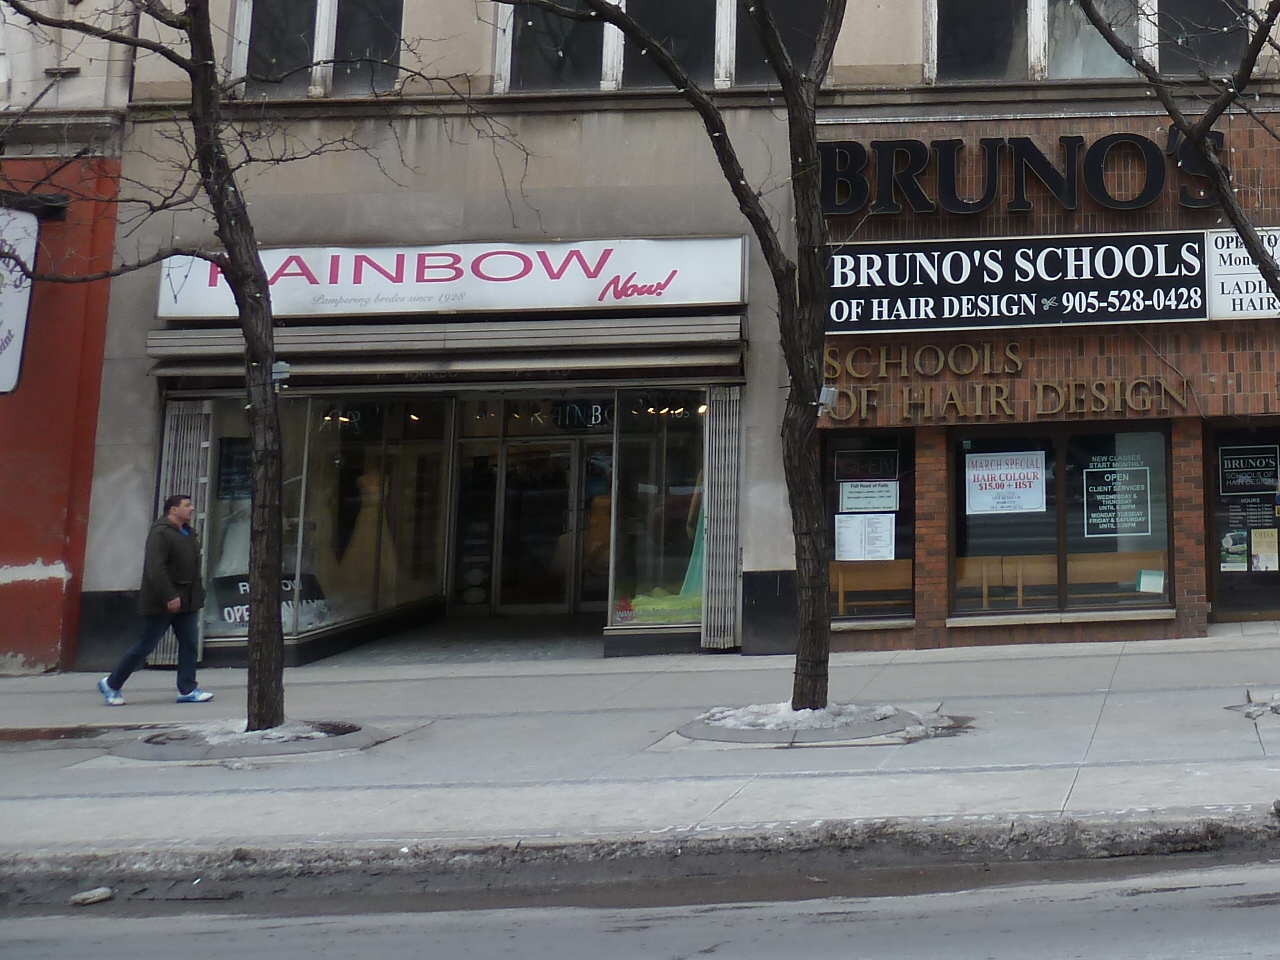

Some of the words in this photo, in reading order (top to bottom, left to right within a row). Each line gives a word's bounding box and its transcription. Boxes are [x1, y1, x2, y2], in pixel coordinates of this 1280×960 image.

[817, 123, 1229, 215] BRUNO'S
[830, 248, 1004, 288] BRUNO'S
[1015, 242, 1202, 283] SCHOOLS
[597, 269, 678, 302] Now!
[310, 293, 371, 307] Pampering
[374, 293, 405, 304] brides
[408, 294, 434, 303] since
[437, 292, 466, 304] 1928
[830, 299, 865, 323] OF
[870, 296, 937, 321] HAIR
[941, 293, 1038, 319] DESIGN
[1062, 287, 1203, 314] 905-528-0428
[824, 341, 1023, 379] SCHOOLS
[827, 388, 879, 421] OF
[902, 383, 1016, 420] HAIR
[1035, 378, 1191, 414] DESIGN
[970, 459, 1002, 471] MARCH
[1005, 457, 1040, 470] SPECIAL
[1089, 461, 1111, 469] START
[1112, 460, 1145, 468] MONTHLY
[1223, 458, 1276, 469] BRUNO'S
[973, 473, 997, 483] HAIR
[999, 472, 1040, 482] COLOUR
[1104, 473, 1129, 482] OPEN
[1225, 471, 1261, 480] SCHOOLS
[978, 482, 1005, 491] $15.00
[1015, 481, 1034, 489] HST
[1245, 478, 1274, 486] DESIGN
[1088, 485, 1112, 493] CLIENT
[1113, 484, 1145, 492] SERVICES
